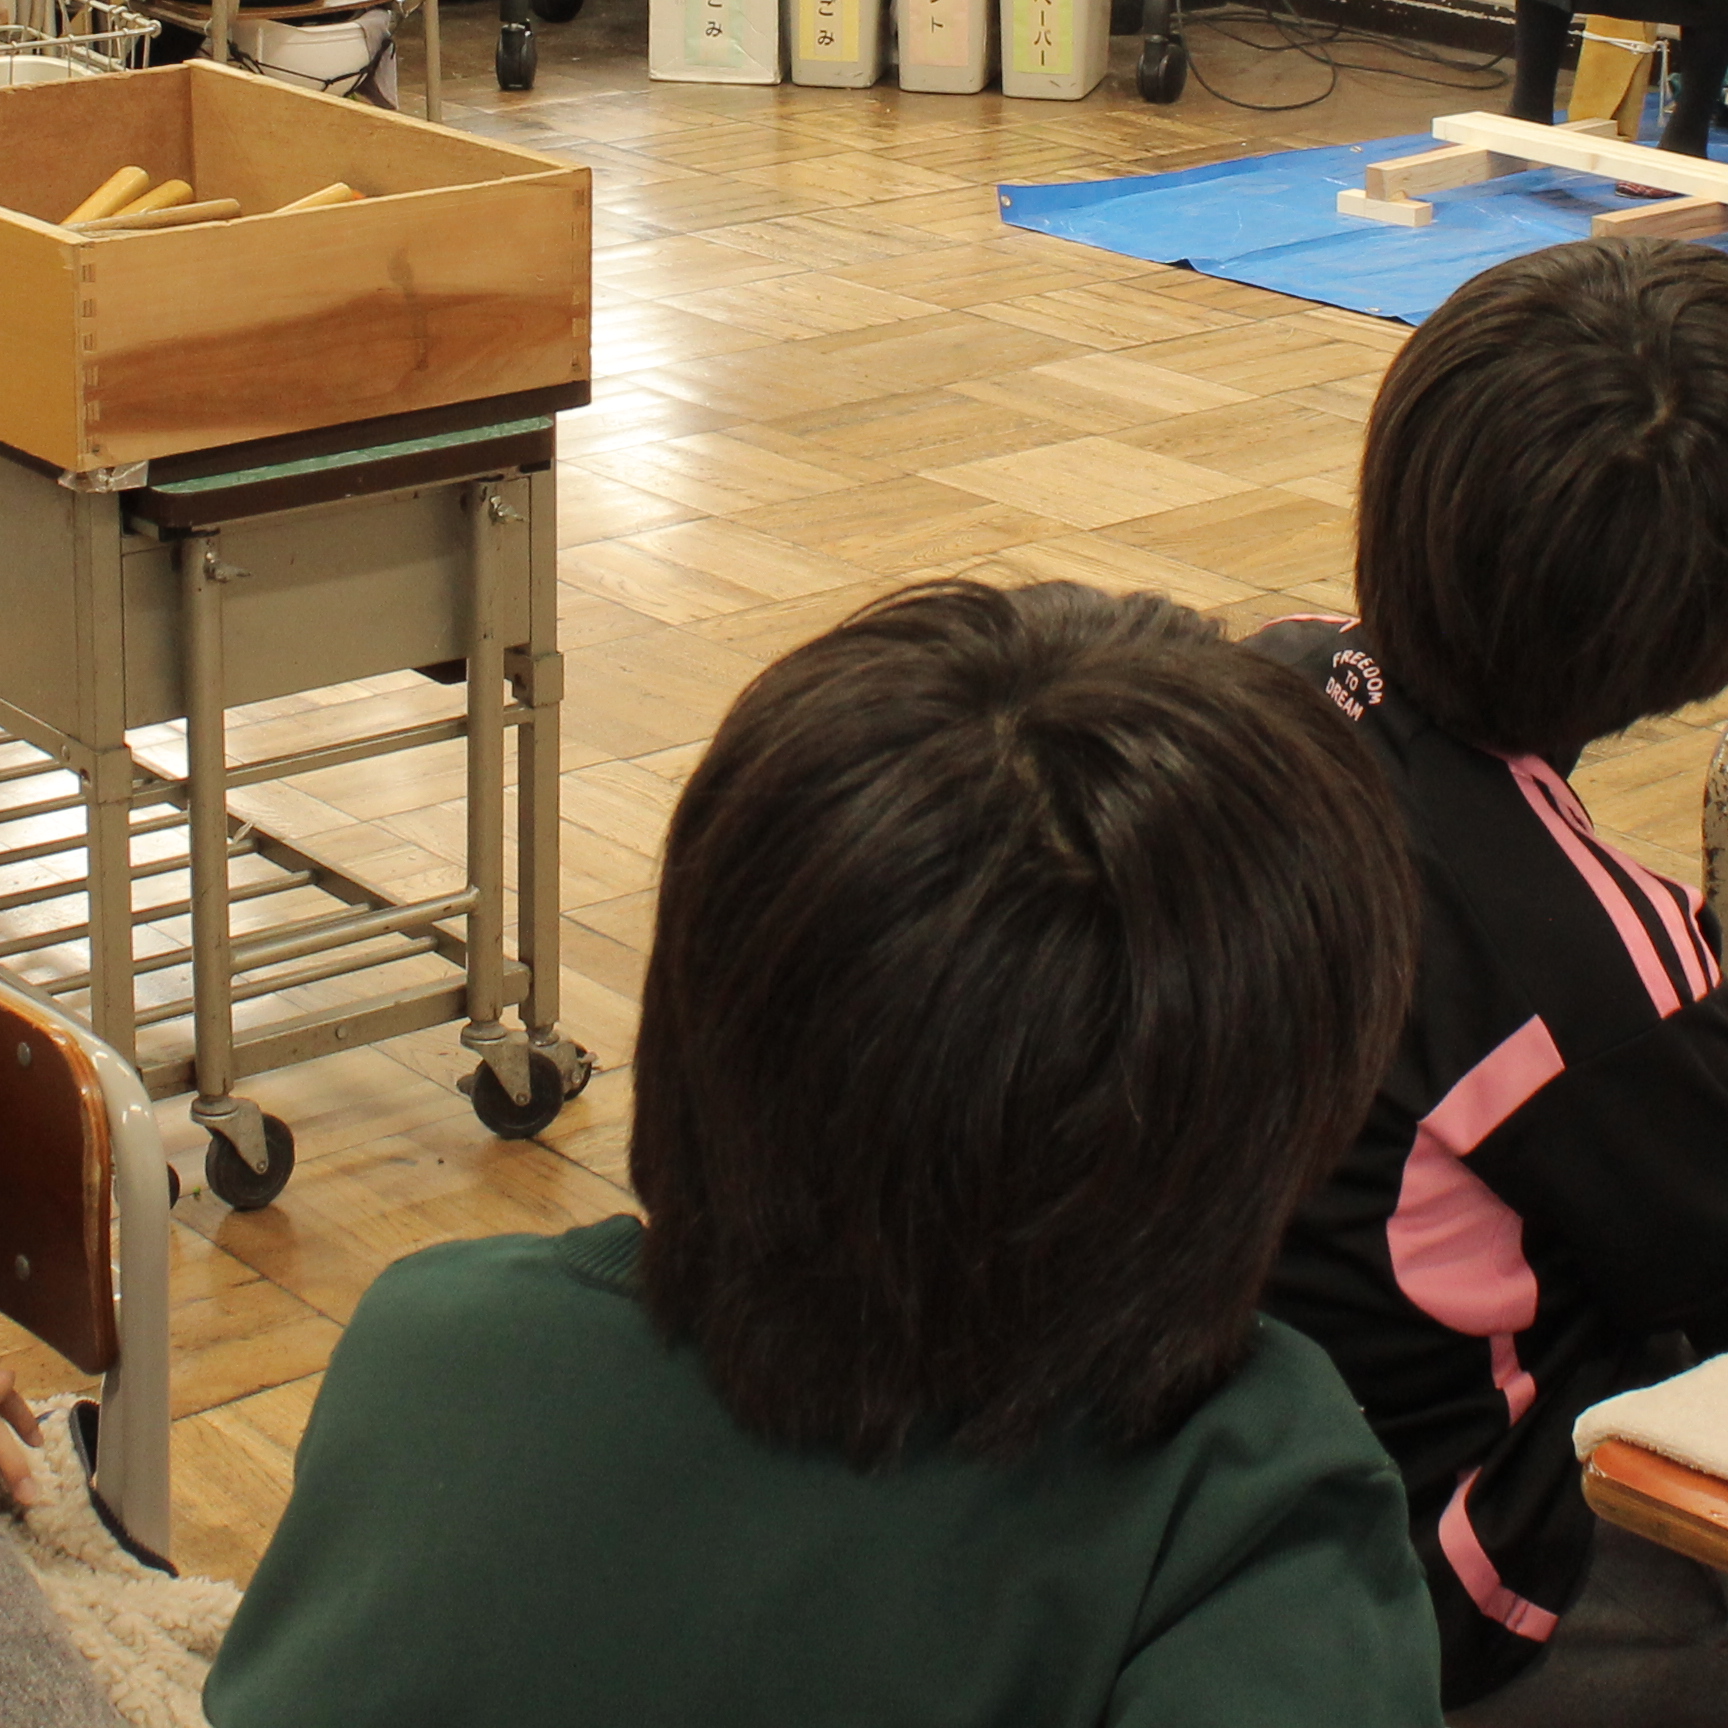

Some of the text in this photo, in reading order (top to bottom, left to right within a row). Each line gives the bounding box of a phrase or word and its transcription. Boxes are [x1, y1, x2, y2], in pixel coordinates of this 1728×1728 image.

[1325, 676, 1364, 722] DREAM
[1332, 649, 1384, 705] FREEDOM
[1345, 669, 1359, 692] TO
